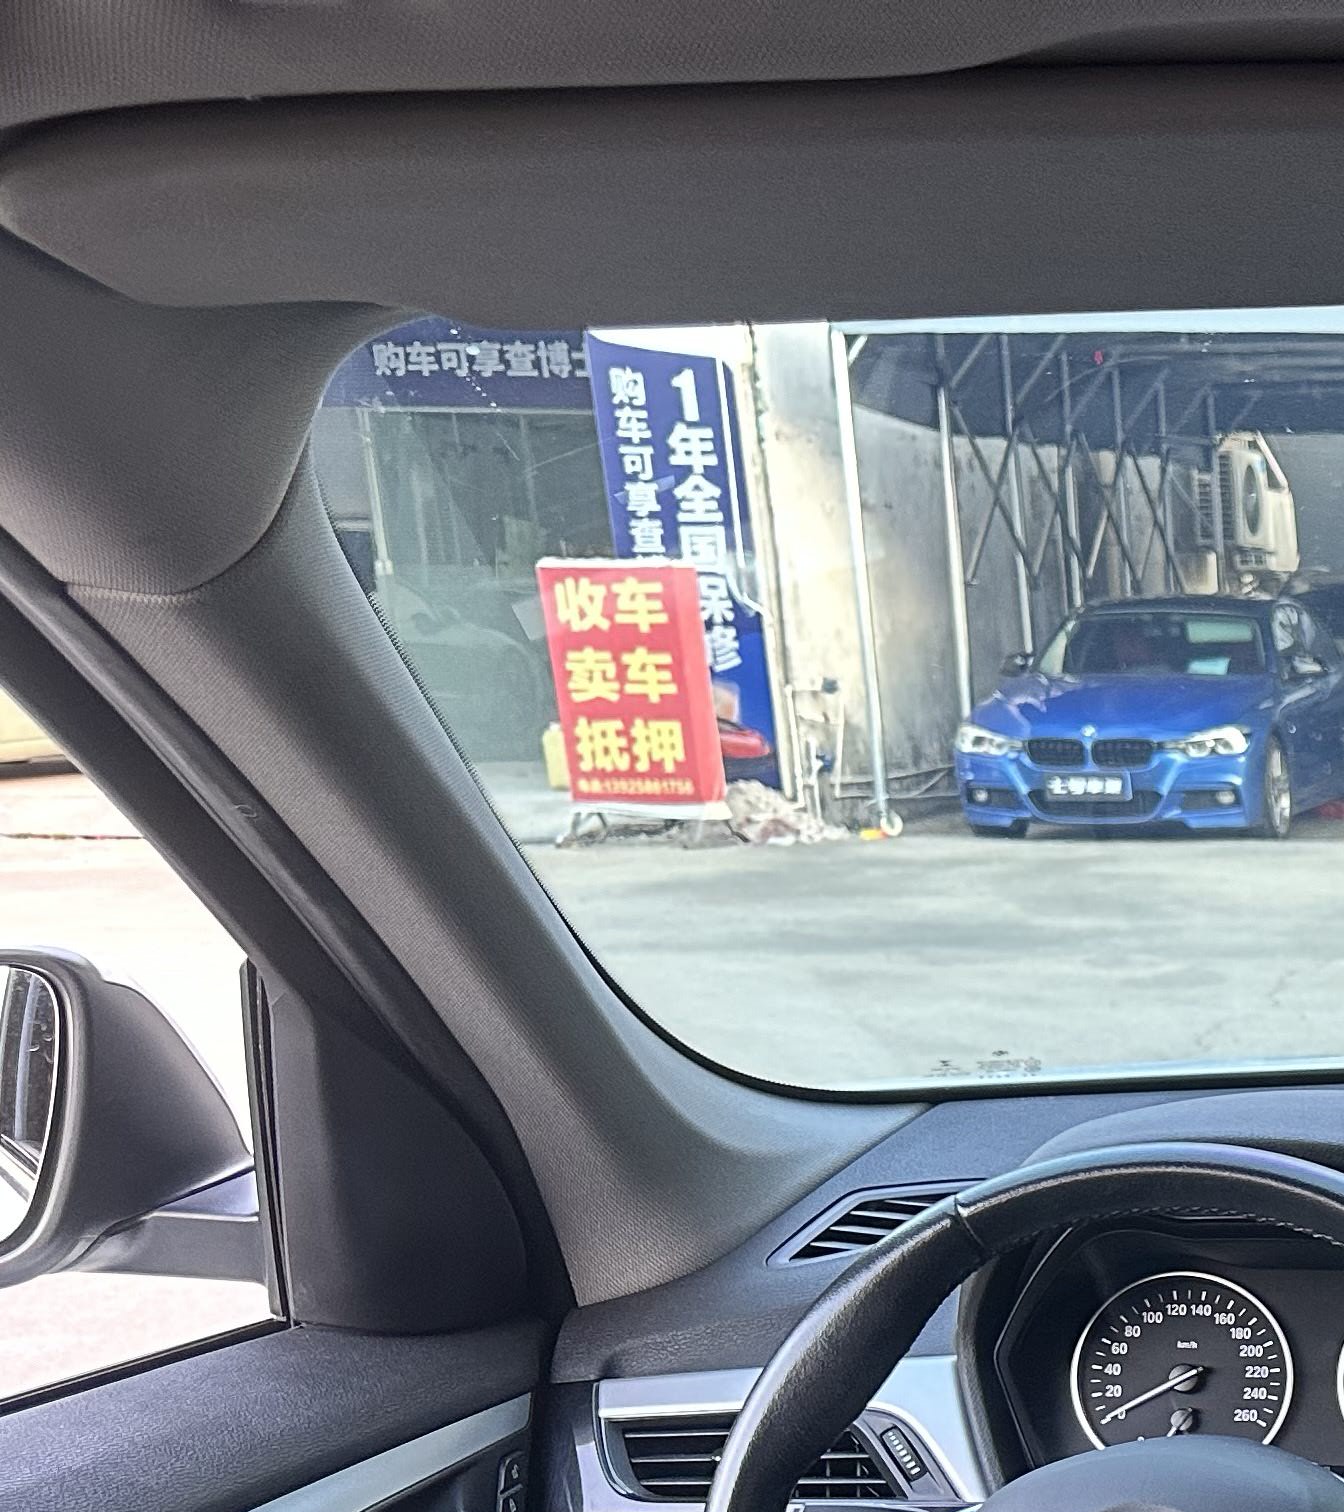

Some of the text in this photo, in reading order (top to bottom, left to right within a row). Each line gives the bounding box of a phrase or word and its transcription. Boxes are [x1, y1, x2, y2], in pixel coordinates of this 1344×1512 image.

[608, 366, 666, 559] 购车可享查
[554, 576, 669, 634] 收车
[565, 646, 679, 704] 卖车
[574, 716, 686, 774] 抵押
[1166, 1304, 1187, 1316] 120
[1190, 1304, 1212, 1316] 140
[1142, 1312, 1163, 1323] 100
[1214, 1313, 1235, 1325] 160
[1124, 1325, 1141, 1337] 80
[1230, 1327, 1251, 1339] 180
[1111, 1343, 1128, 1354] 60
[1239, 1345, 1264, 1357] 200
[1104, 1363, 1121, 1375] 40
[1245, 1366, 1268, 1378] 220
[1105, 1384, 1122, 1397] 20
[1243, 1387, 1267, 1400] 240
[1234, 1410, 1258, 1422] 260
